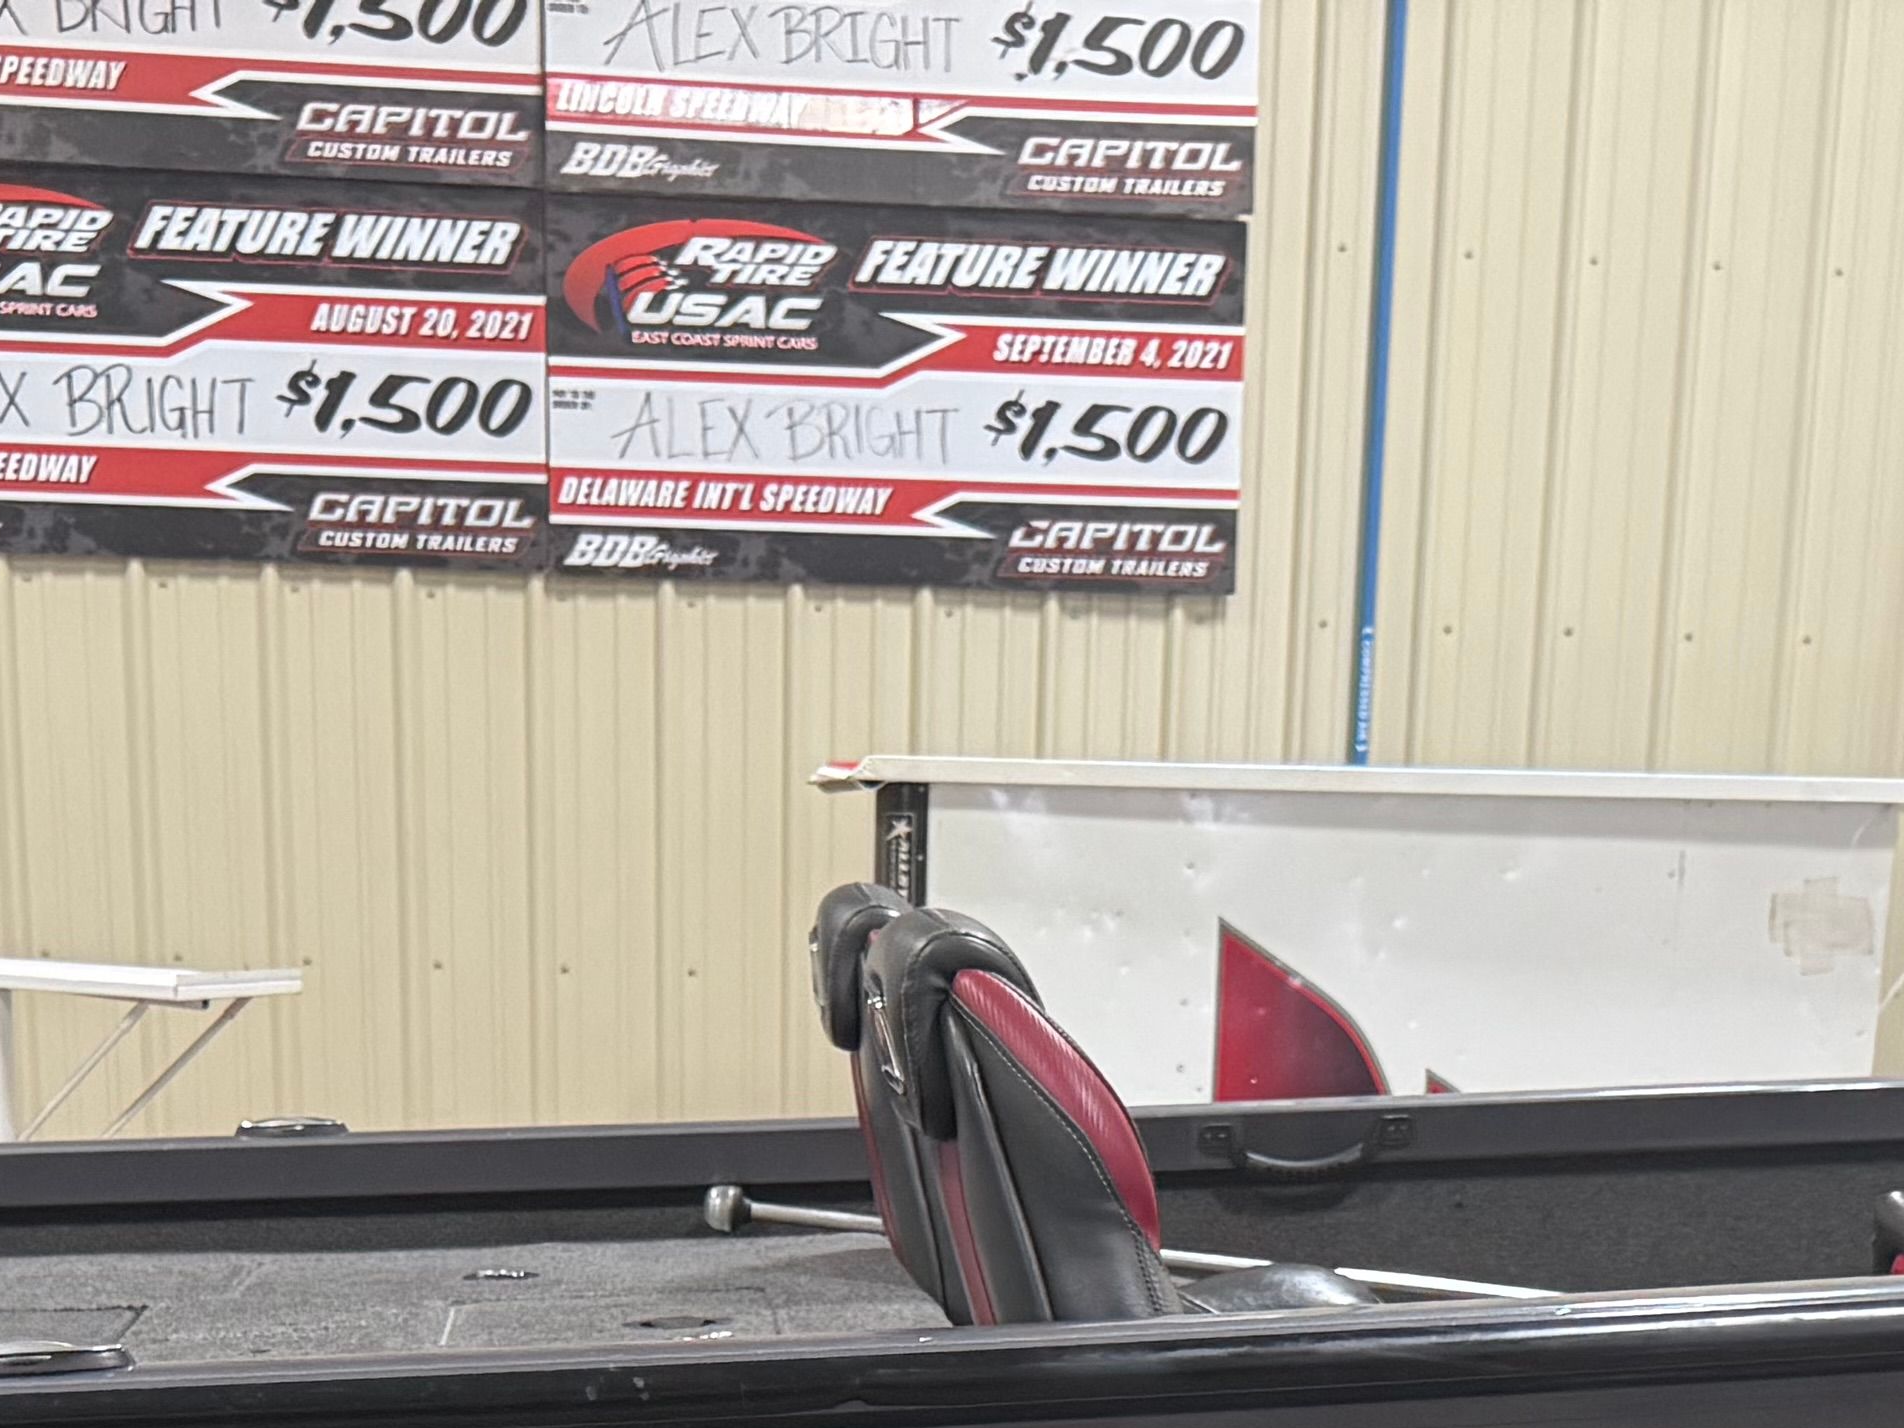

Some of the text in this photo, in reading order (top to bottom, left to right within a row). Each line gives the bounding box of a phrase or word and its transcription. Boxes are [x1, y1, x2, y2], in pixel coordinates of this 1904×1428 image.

[603, 0, 962, 74] ALEX BRIGHT
[991, 0, 1244, 80] $1,500
[555, 77, 667, 117] LINCOLN
[297, 102, 530, 141] CAPITOL
[307, 141, 513, 168] CUSTOM TRAILERS
[561, 142, 659, 178] BDB
[1017, 137, 1242, 171] CAPITOL
[1027, 175, 1226, 196] CUSTOM TRAILERS
[133, 205, 521, 265] FEATURE WINNER
[674, 236, 839, 266] RAPID
[709, 263, 821, 286] TIRE
[854, 240, 1227, 297] FEATURE WINNER
[55, 303, 98, 318] CARS
[310, 303, 533, 342] AUGUST 20, 2021
[626, 291, 824, 331] USAC
[631, 331, 819, 350] EAST COAST SPRINT CARS
[993, 333, 1234, 370] SEPTEMBER 4, 2021
[53, 363, 256, 440] BRIGHT
[276, 358, 533, 440] $1,500
[611, 391, 959, 466] ALEX BRIGHT
[983, 389, 1228, 467] $1,500
[308, 492, 538, 529] CAPITOL
[558, 476, 893, 516] DELAWARE INT'L SPEEDWAY
[318, 531, 519, 554] CUSTOM TRAILERS
[564, 534, 659, 569] BDB
[1008, 520, 1227, 554] CAPITOL
[1018, 557, 1210, 578] CUSTOM TRAILERS
